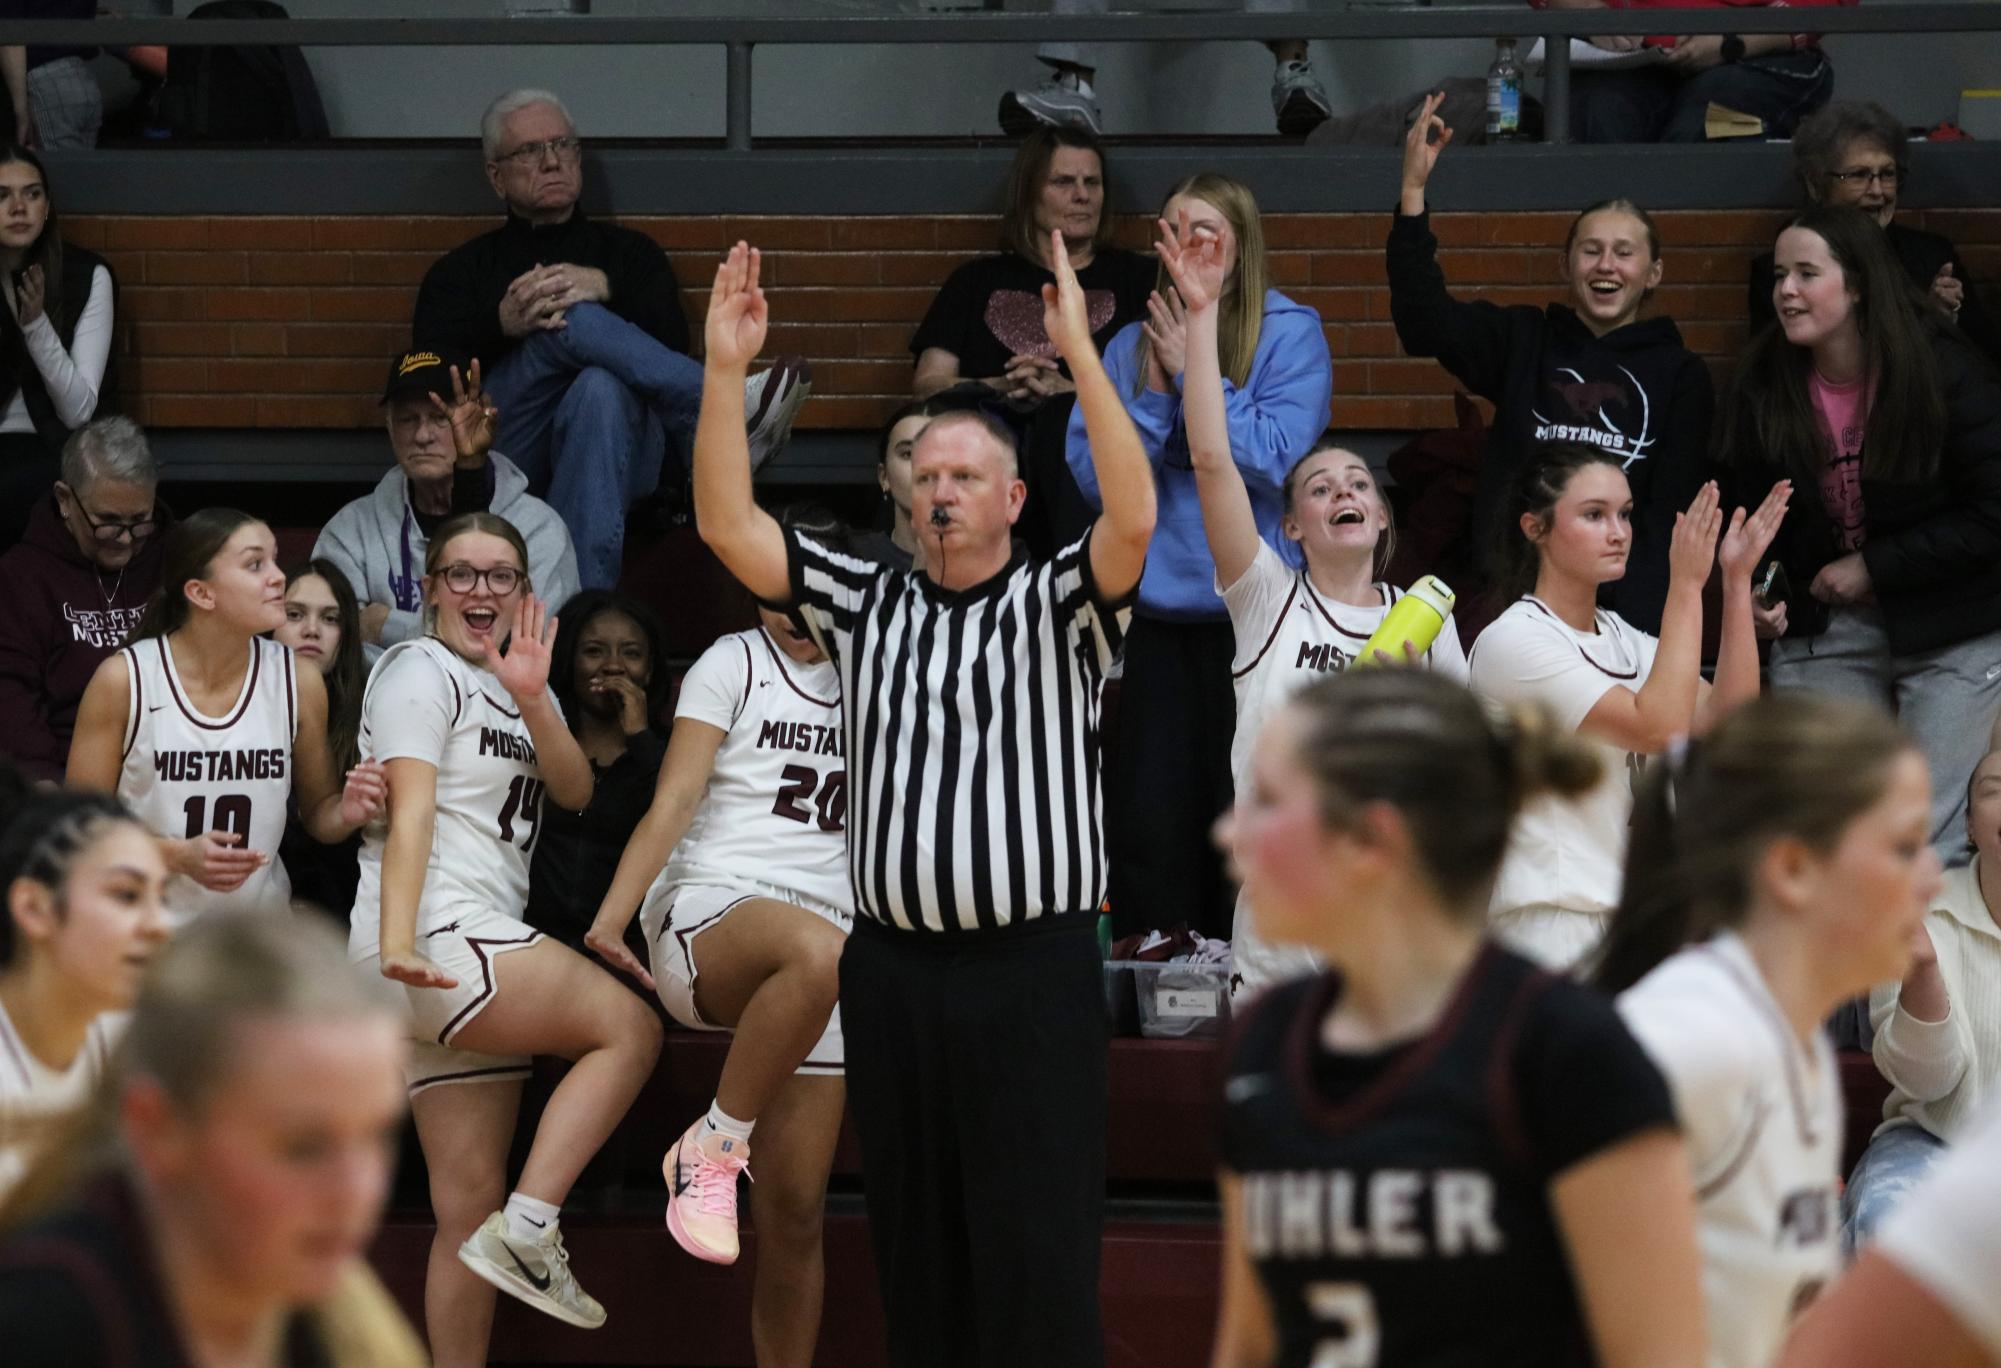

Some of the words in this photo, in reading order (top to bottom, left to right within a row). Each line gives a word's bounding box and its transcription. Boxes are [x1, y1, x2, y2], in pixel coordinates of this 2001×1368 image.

[1535, 424, 1624, 448] MUSTANGS
[153, 748, 285, 781] MUSTANGS
[498, 774, 545, 853] 14
[771, 763, 847, 832] 20
